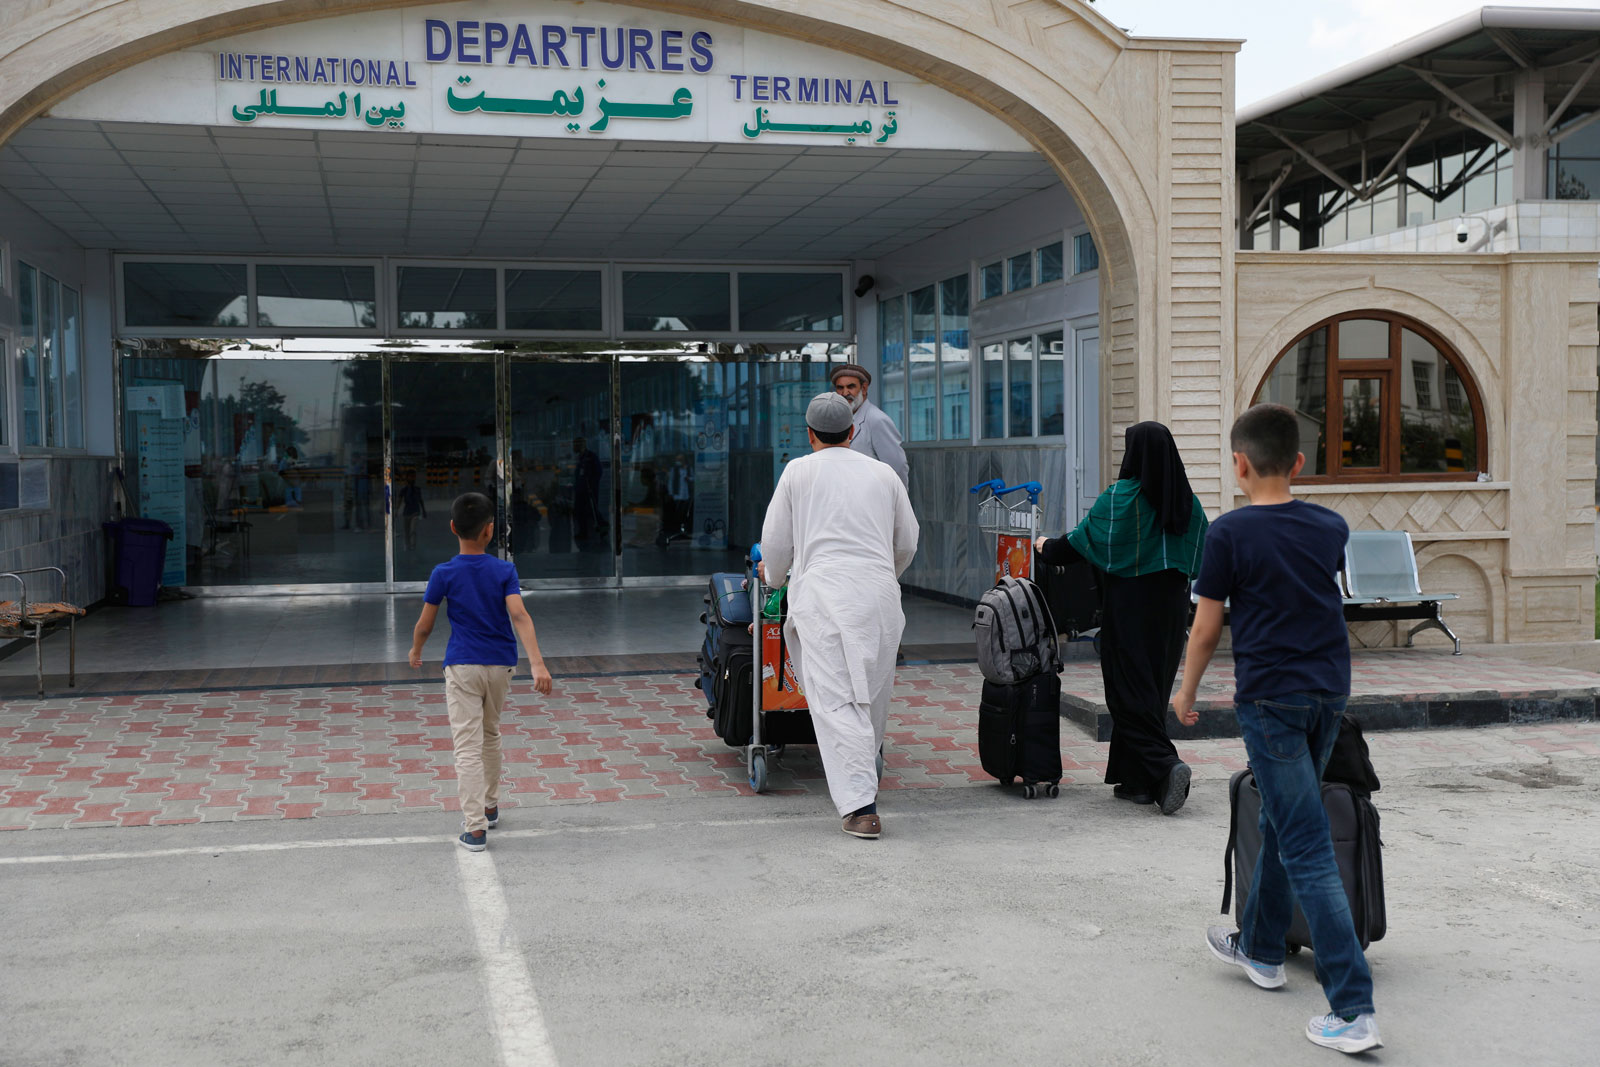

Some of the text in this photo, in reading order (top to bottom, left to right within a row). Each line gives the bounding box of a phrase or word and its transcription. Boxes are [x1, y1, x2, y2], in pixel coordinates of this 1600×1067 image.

[426, 19, 714, 73] DEPARTURES
[219, 53, 417, 86] INTERNATIONAL
[730, 75, 899, 105] TERMINAL
[446, 75, 694, 132] عزیمت
